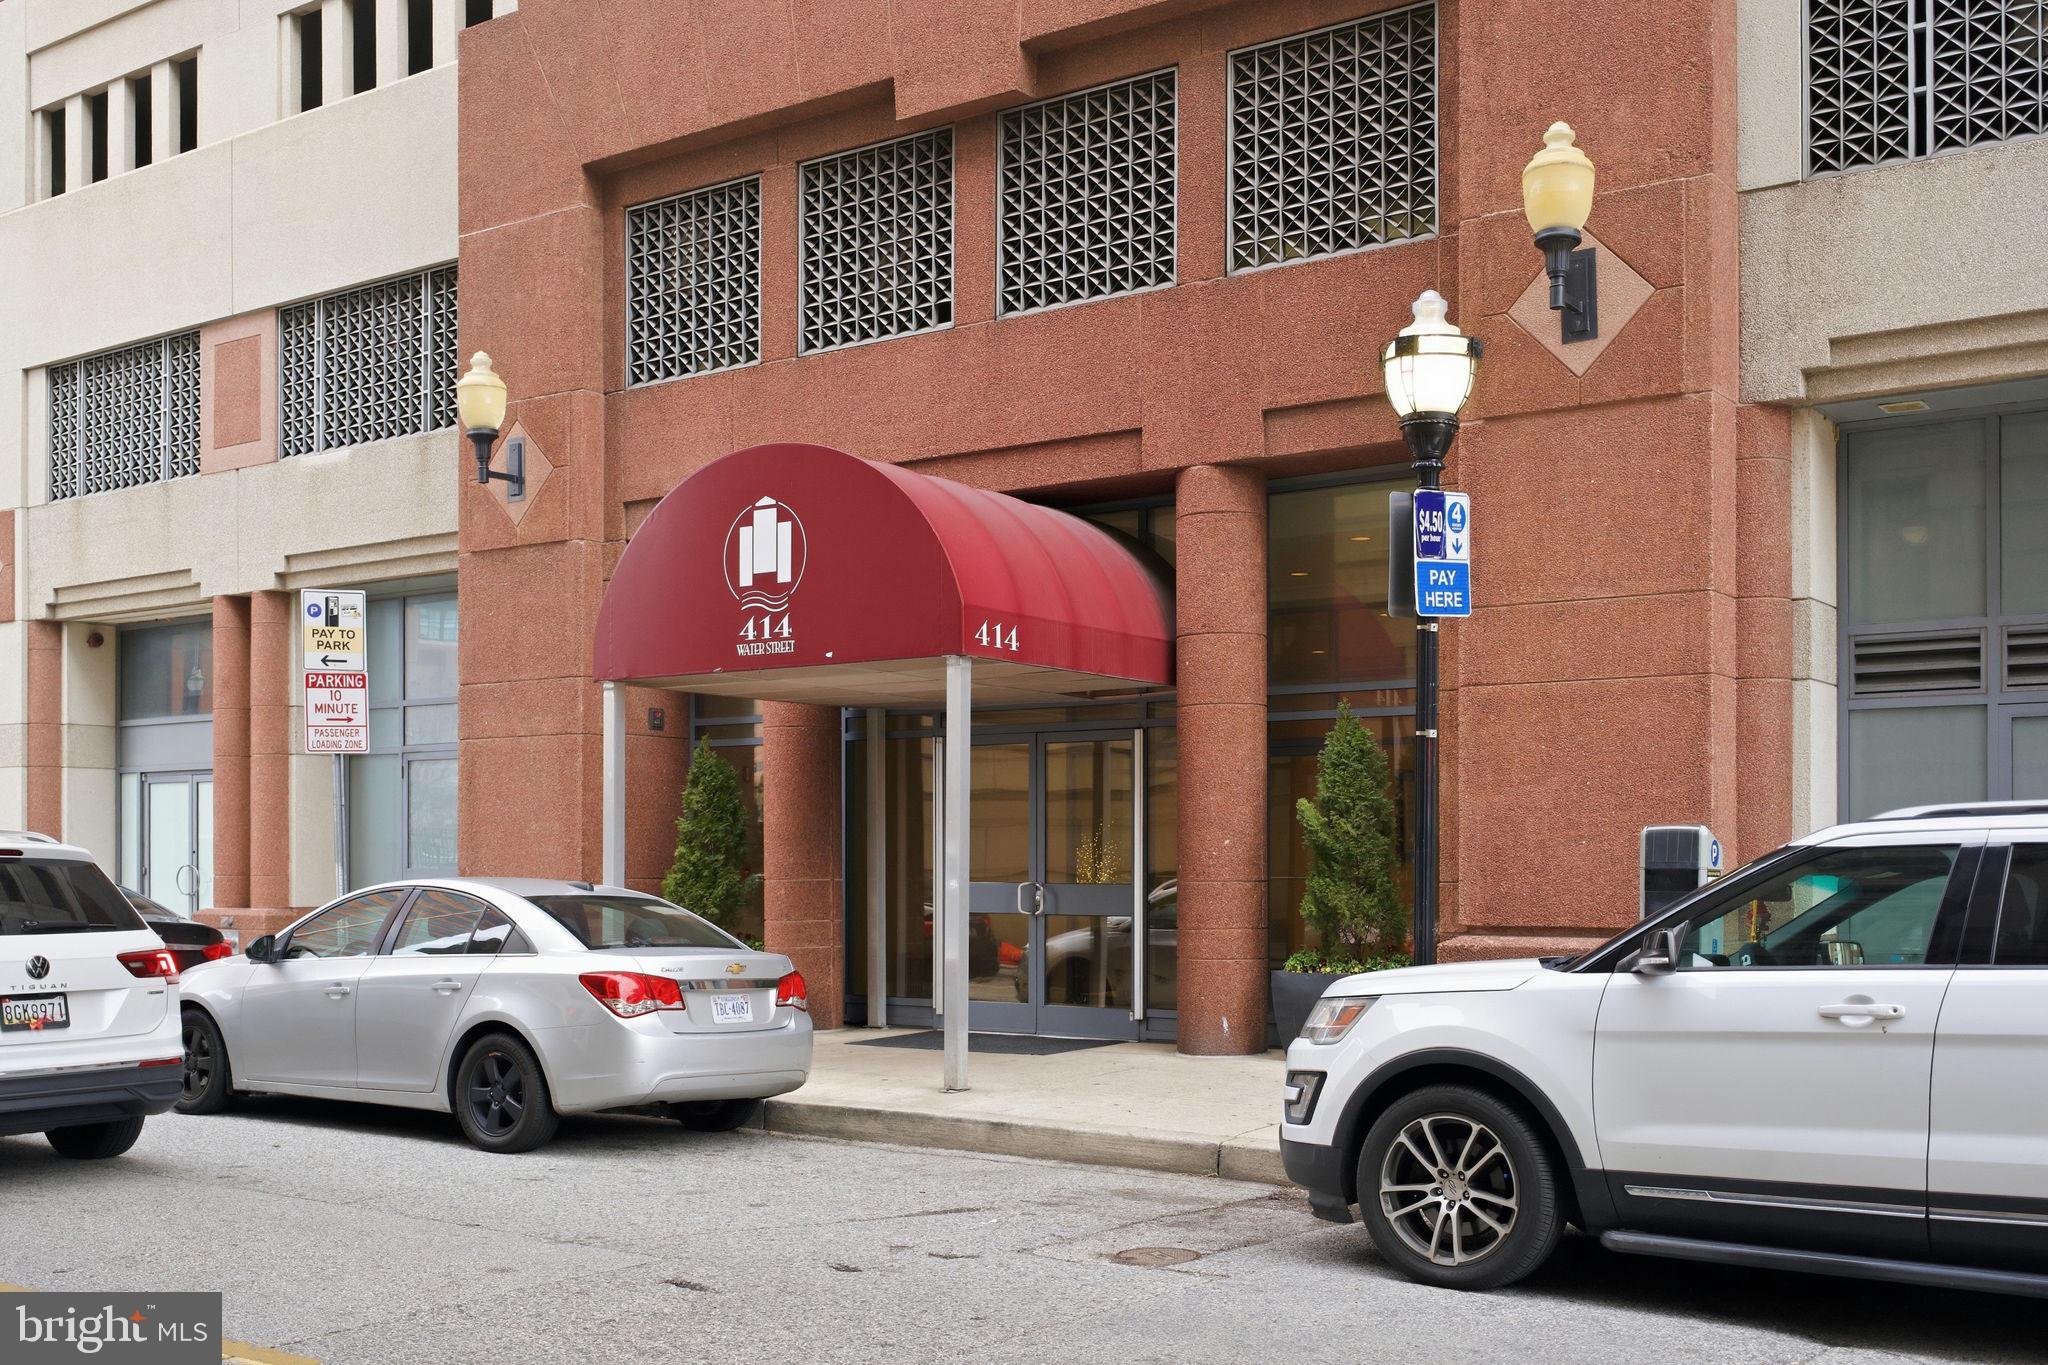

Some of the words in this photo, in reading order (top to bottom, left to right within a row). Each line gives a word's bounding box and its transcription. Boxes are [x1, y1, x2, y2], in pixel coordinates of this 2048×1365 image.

[1419, 508, 1443, 533] $4.50
[1452, 503, 1462, 523] 4
[1429, 569, 1456, 586] PAY
[1425, 591, 1463, 607] HERE
[739, 612, 792, 640] 414
[312, 628, 335, 639] PAY
[339, 629, 356, 640] TO
[975, 619, 1020, 651] 414
[316, 640, 351, 651] PARK
[736, 642, 765, 656] WATER
[766, 640, 795, 655] STREET
[308, 674, 364, 688] PARKING
[330, 690, 342, 701] 10
[314, 703, 358, 714] MINUTE
[314, 728, 360, 738] PASSENGER
[312, 739, 342, 749] LOADING
[344, 739, 363, 749] ZONE
[10, 983, 68, 991] TIGUAN
[4, 1002, 64, 1022] 8GK8971
